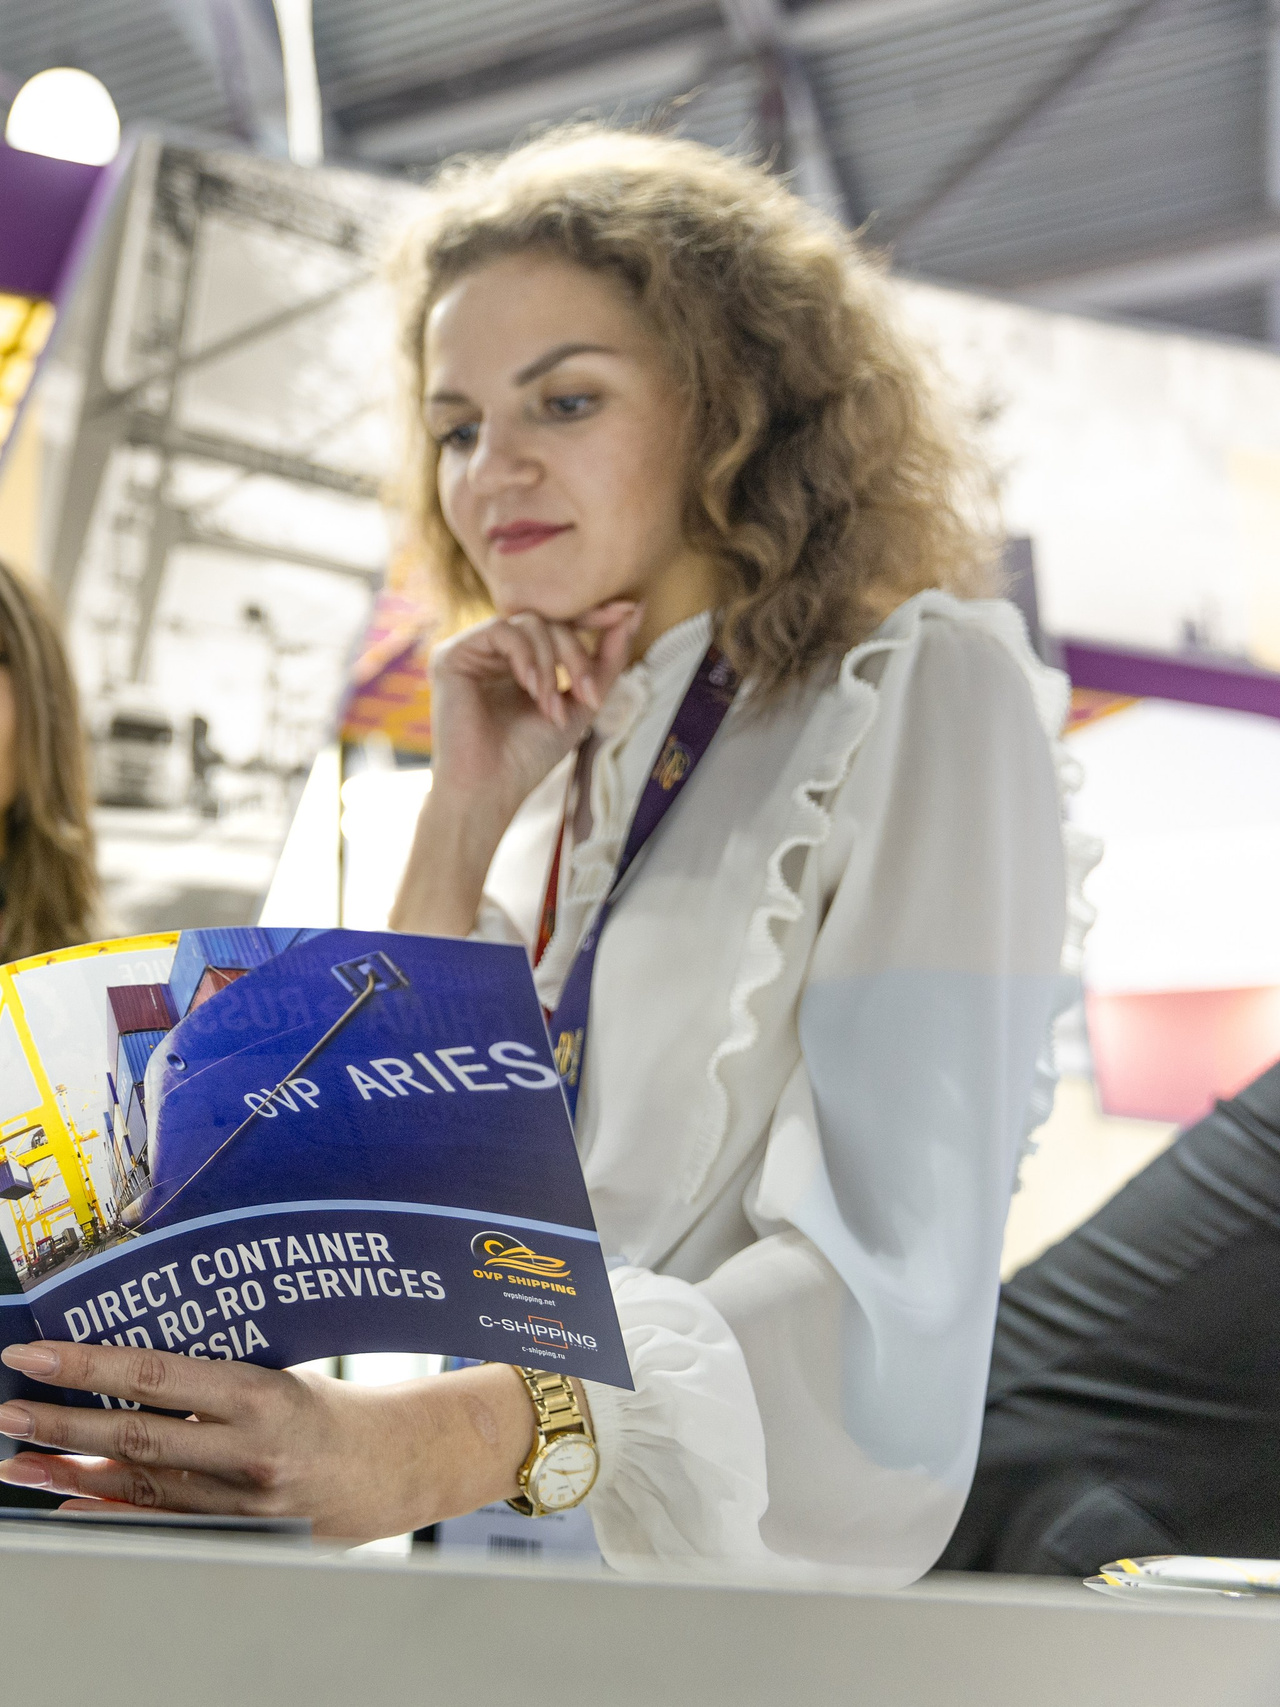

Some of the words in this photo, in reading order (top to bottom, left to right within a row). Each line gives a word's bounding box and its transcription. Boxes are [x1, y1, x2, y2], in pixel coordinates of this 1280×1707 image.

[243, 1077, 321, 1118] OVP
[345, 1040, 560, 1101] ARIES
[63, 1261, 182, 1343] DIRECT
[190, 1231, 395, 1286] CONTAINER
[472, 1269, 503, 1281] OVP
[507, 1275, 577, 1296] SHIPPING
[502, 1290, 556, 1307] ovpshipping.net
[156, 1279, 267, 1349] RO-RO
[272, 1266, 446, 1304] SERVICES
[178, 1319, 270, 1361] SSIA
[478, 1315, 598, 1348] C-SHIPPING
[521, 1346, 566, 1360] c-shipping.ru
